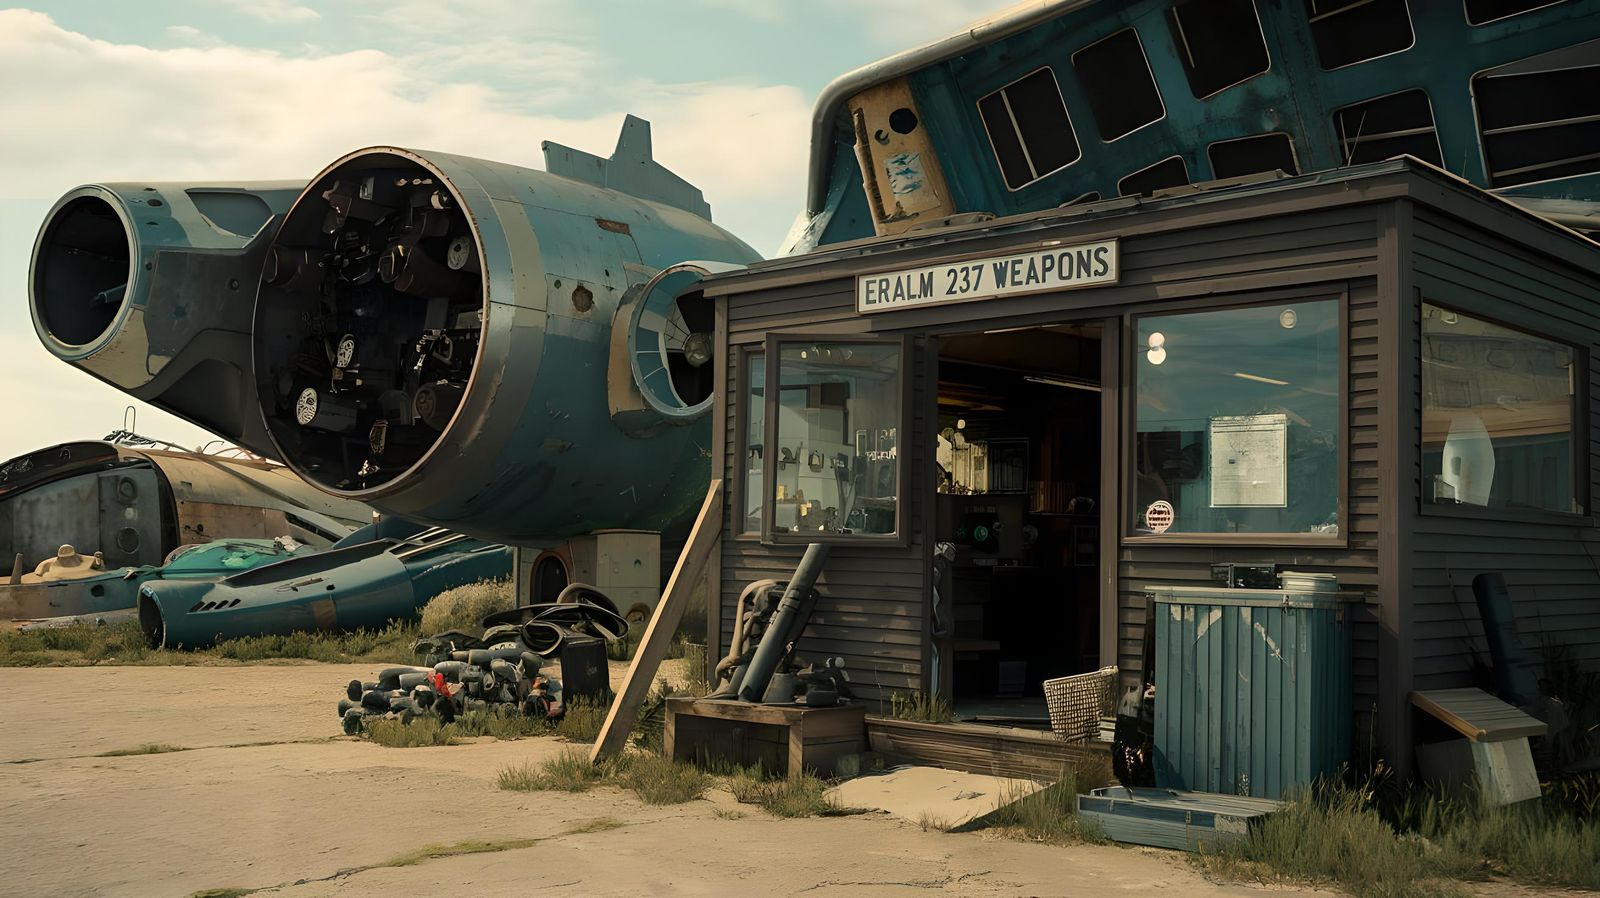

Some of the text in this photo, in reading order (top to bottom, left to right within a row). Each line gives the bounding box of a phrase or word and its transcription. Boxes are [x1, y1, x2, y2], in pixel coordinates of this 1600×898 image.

[865, 246, 1109, 305] ERALM 237 WEAPONS
